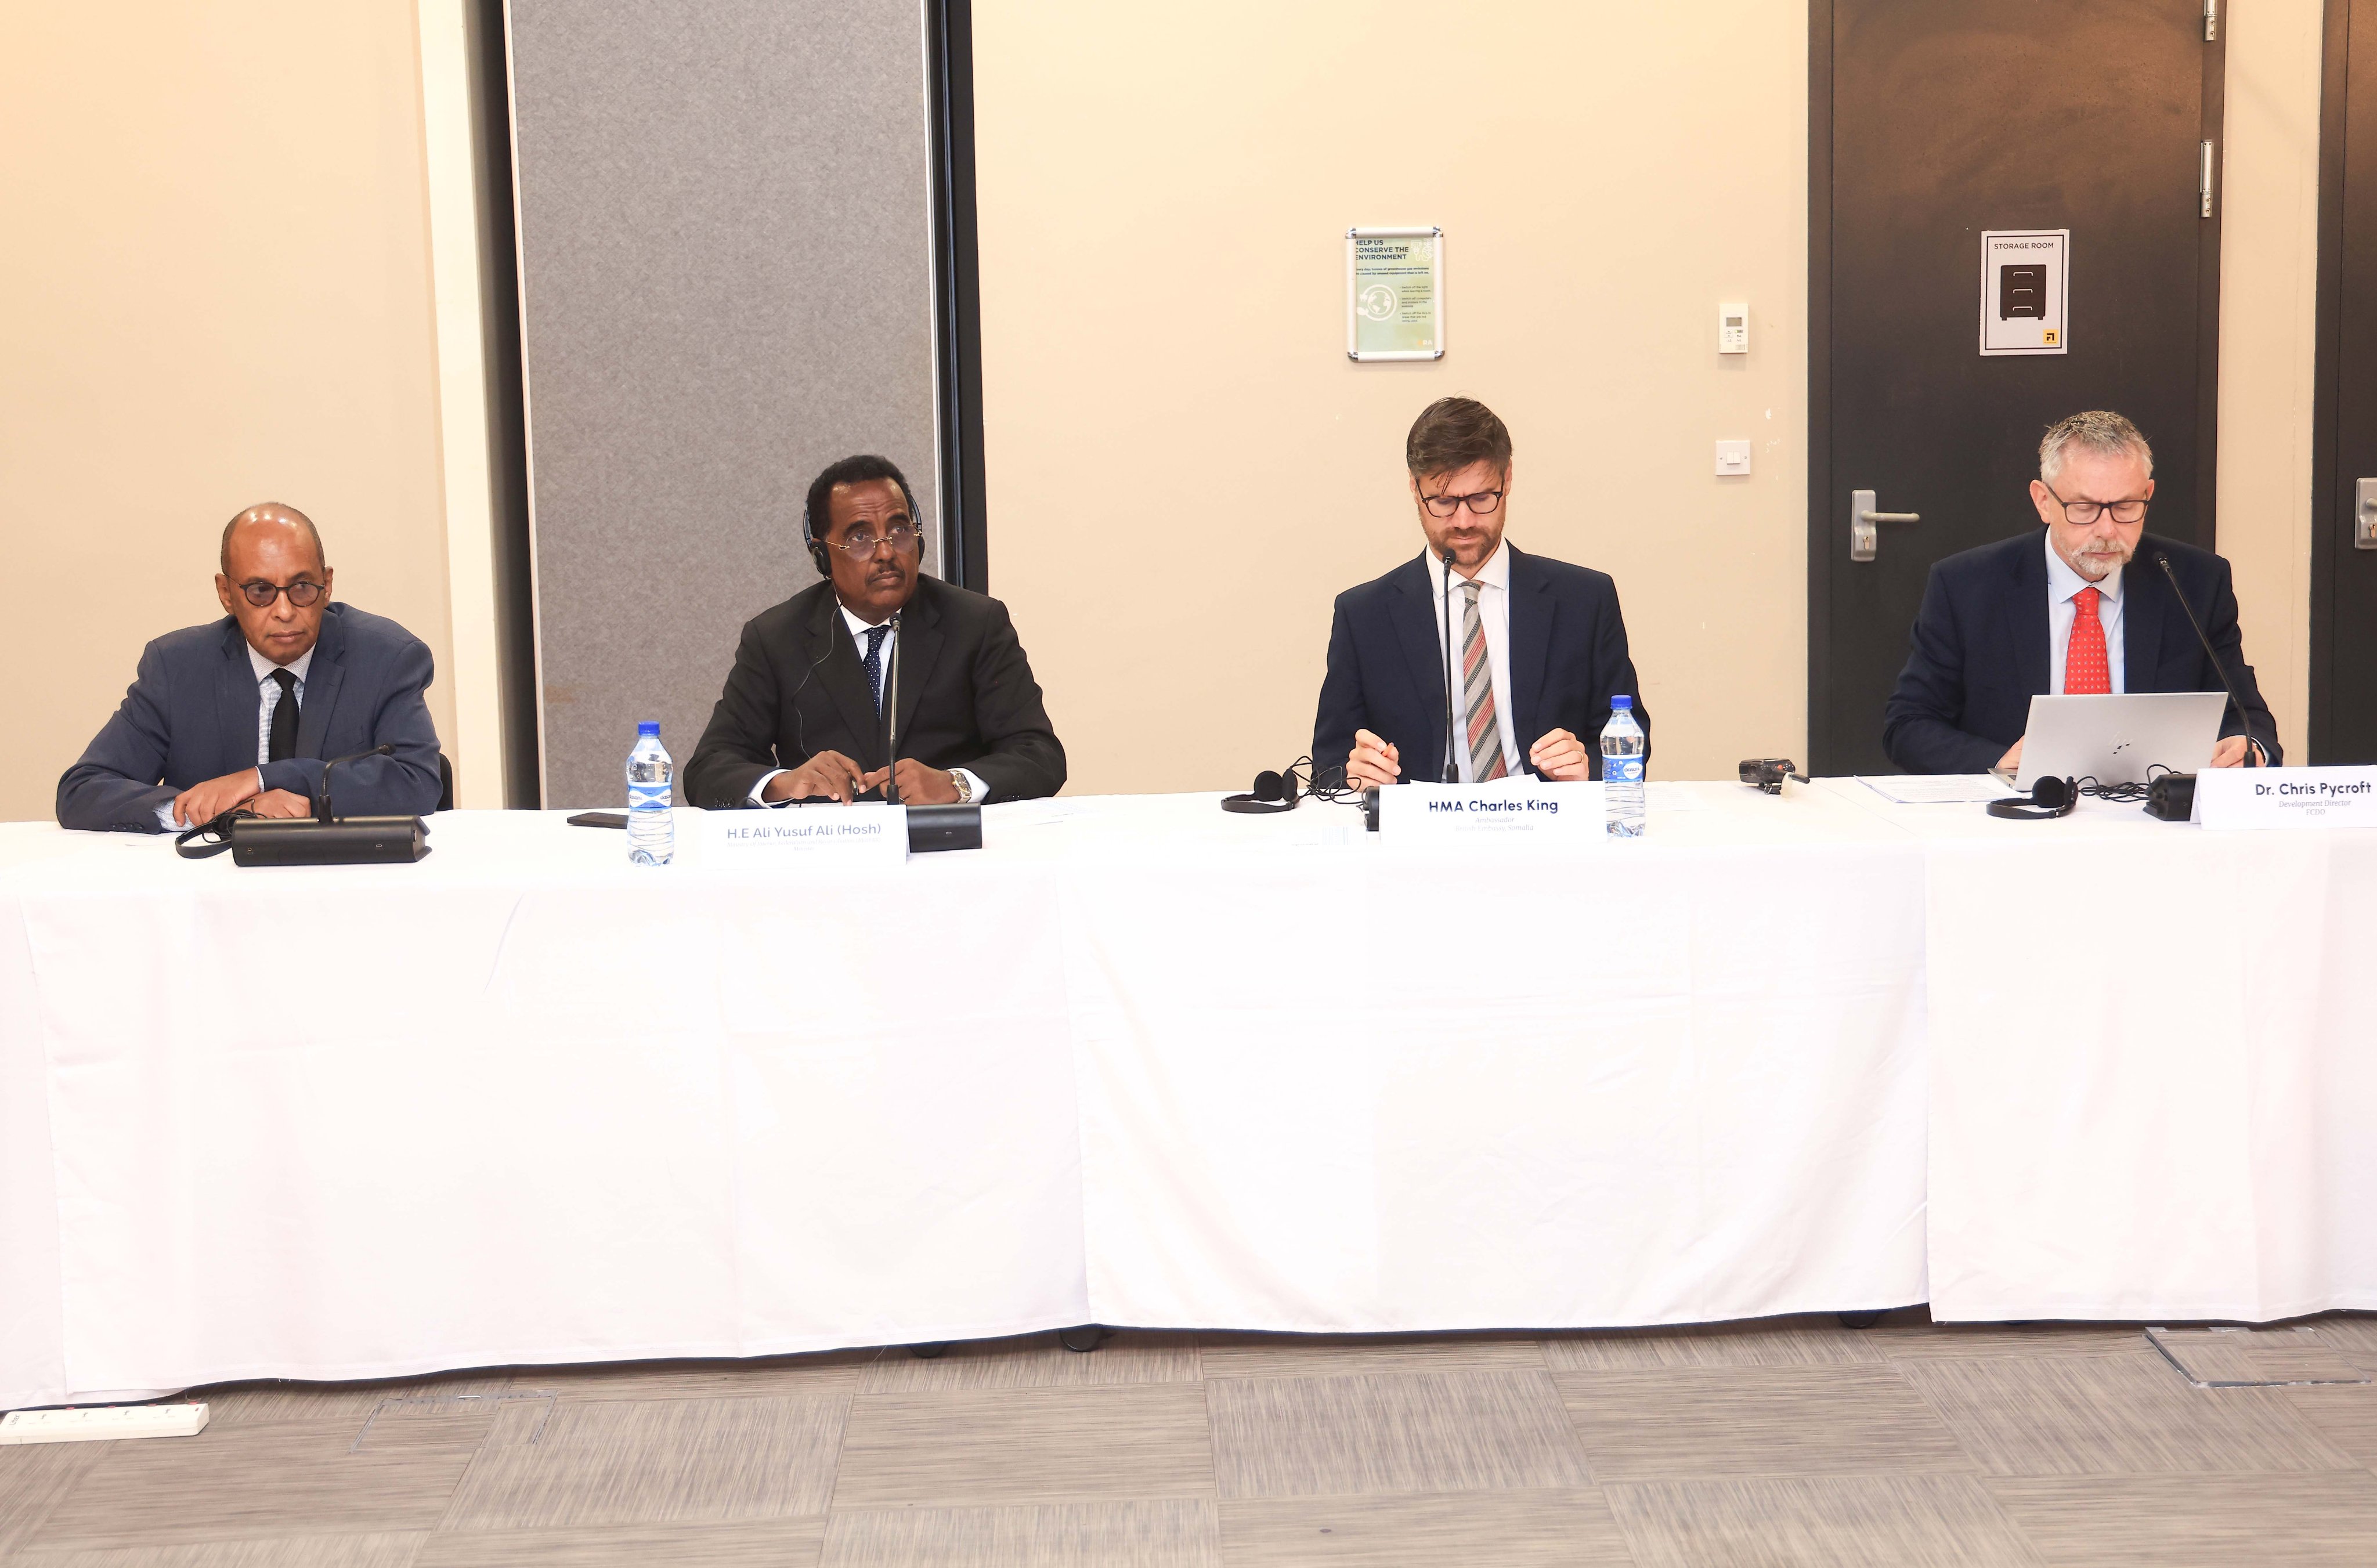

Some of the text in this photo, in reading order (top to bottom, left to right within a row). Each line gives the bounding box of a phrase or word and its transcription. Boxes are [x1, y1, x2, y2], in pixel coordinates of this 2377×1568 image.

[2255, 781, 2371, 797] Dr. Chris Pycroft
[1429, 799, 1558, 814] HMA Charles King
[2279, 800, 2323, 808] Development
[728, 823, 881, 839] H.E Ali Yusuf Ali (Hosh)
